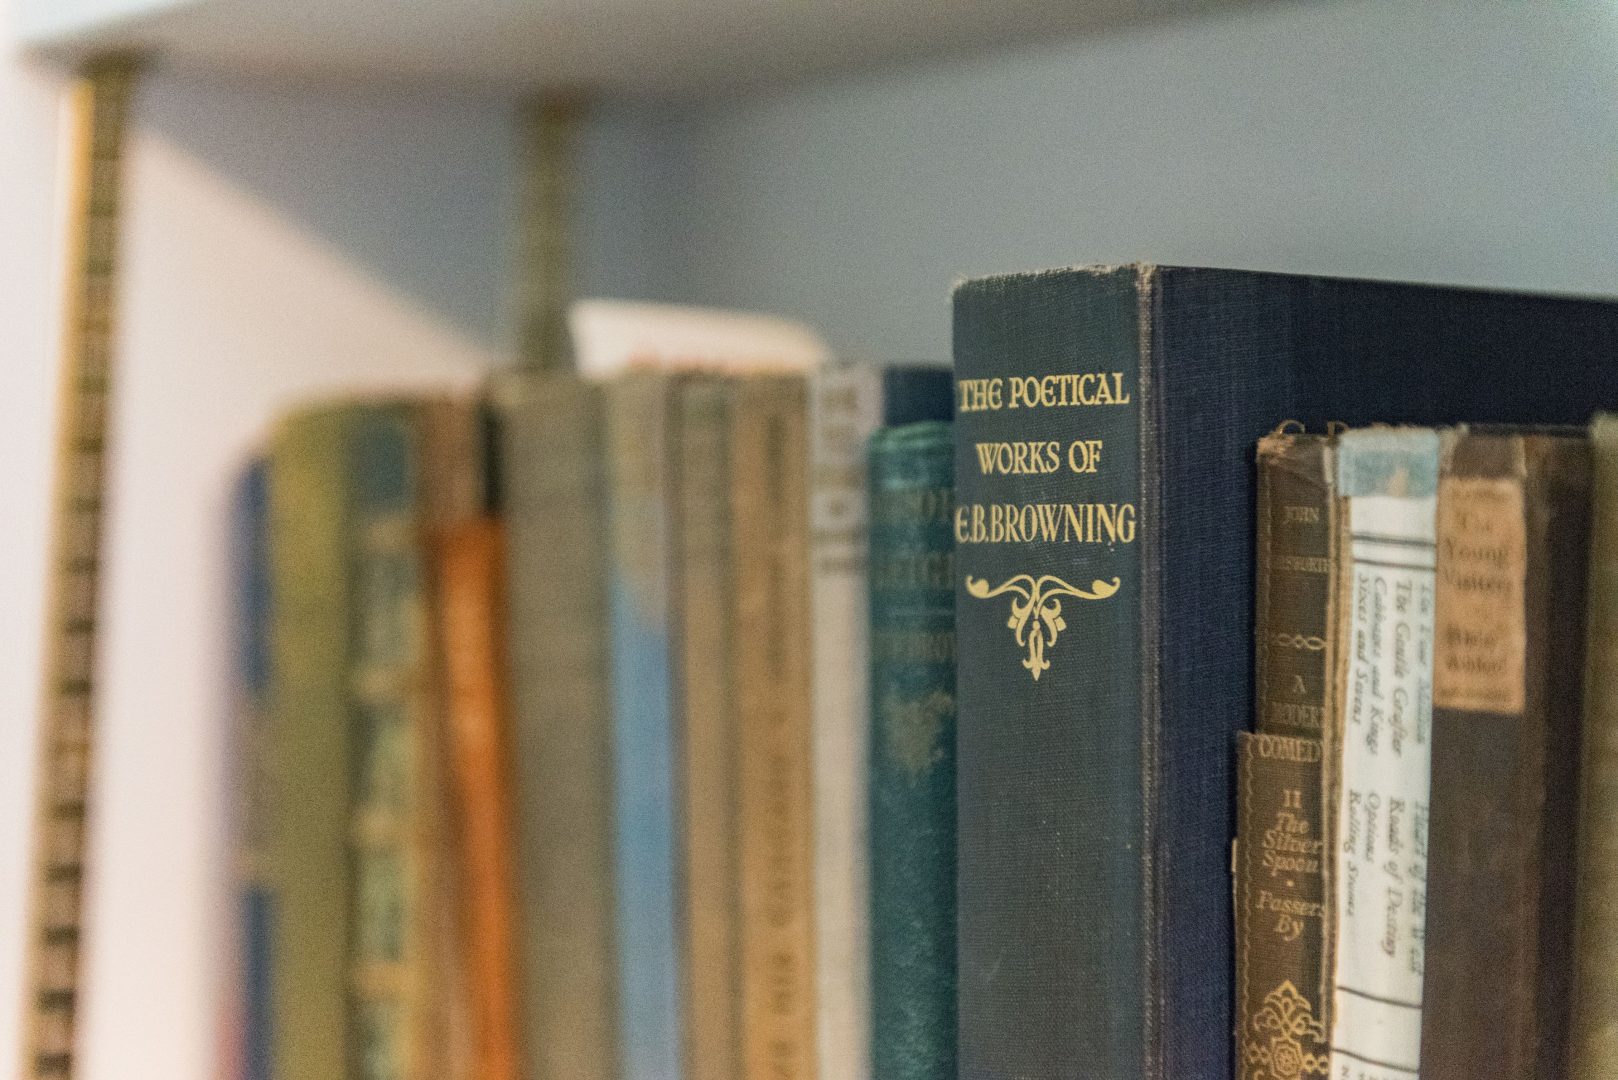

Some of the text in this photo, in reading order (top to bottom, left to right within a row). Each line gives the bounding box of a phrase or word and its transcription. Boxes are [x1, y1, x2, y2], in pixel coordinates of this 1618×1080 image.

[959, 372, 1130, 412] THE POETICAL
[975, 440, 1103, 475] WORKS OF
[1352, 573, 1372, 726] Sixes and Sevens
[1388, 579, 1414, 758] The Gentle Grafter
[1371, 664, 1385, 700] and
[1366, 705, 1385, 756] Kings
[1275, 811, 1310, 834] The
[1364, 791, 1382, 864] Options
[1262, 849, 1319, 877] Spoon
[1343, 789, 1362, 918] Rolling Stones
[1383, 859, 1404, 885] of
[1274, 914, 1305, 942] By
